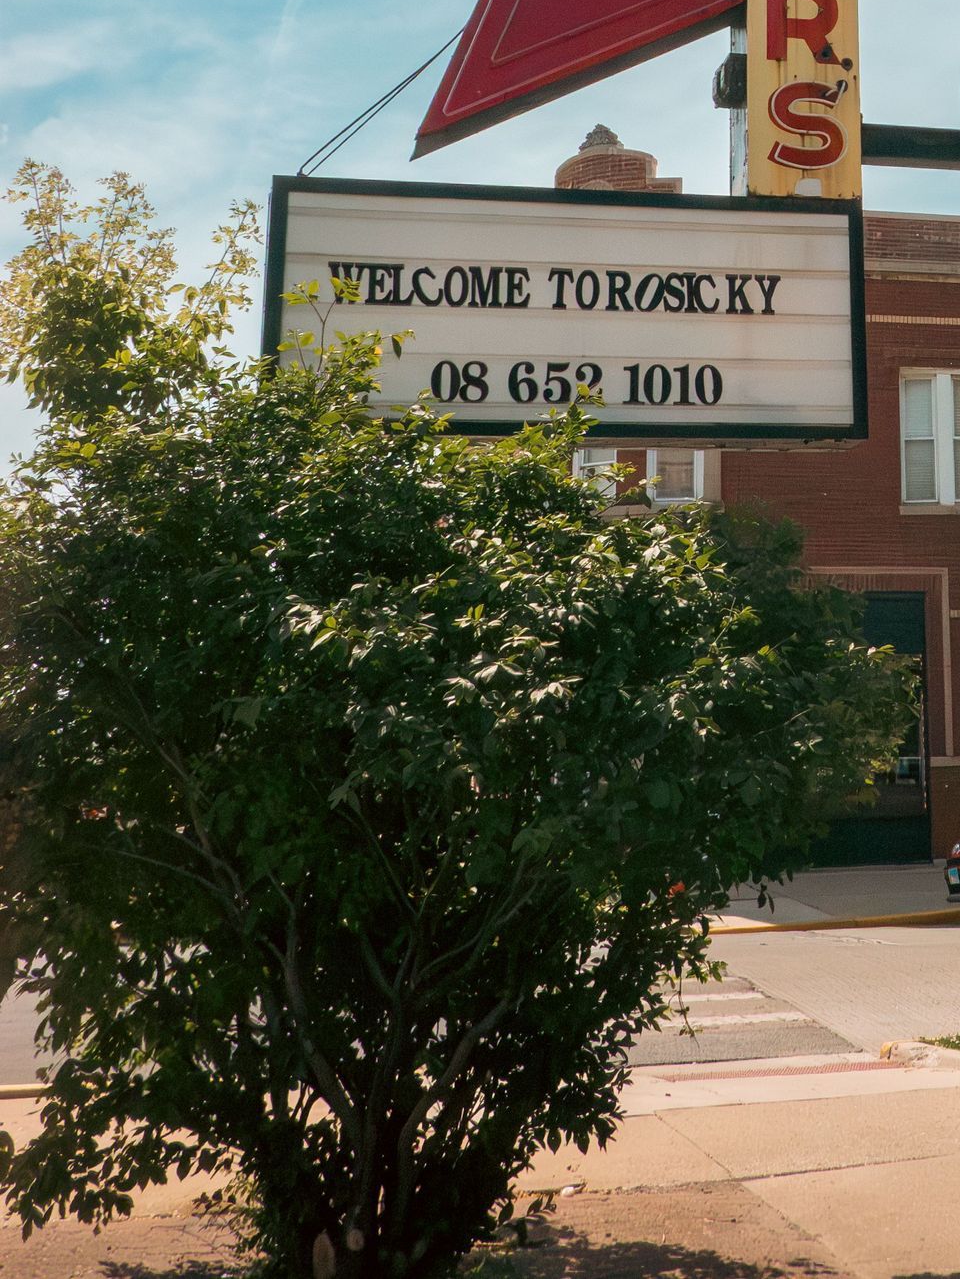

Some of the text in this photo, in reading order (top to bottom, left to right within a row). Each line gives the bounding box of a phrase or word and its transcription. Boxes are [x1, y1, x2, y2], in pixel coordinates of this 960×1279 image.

[328, 261, 781, 315] WELCOME TO ROSICKY
[431, 360, 724, 406] 08 652 1010
